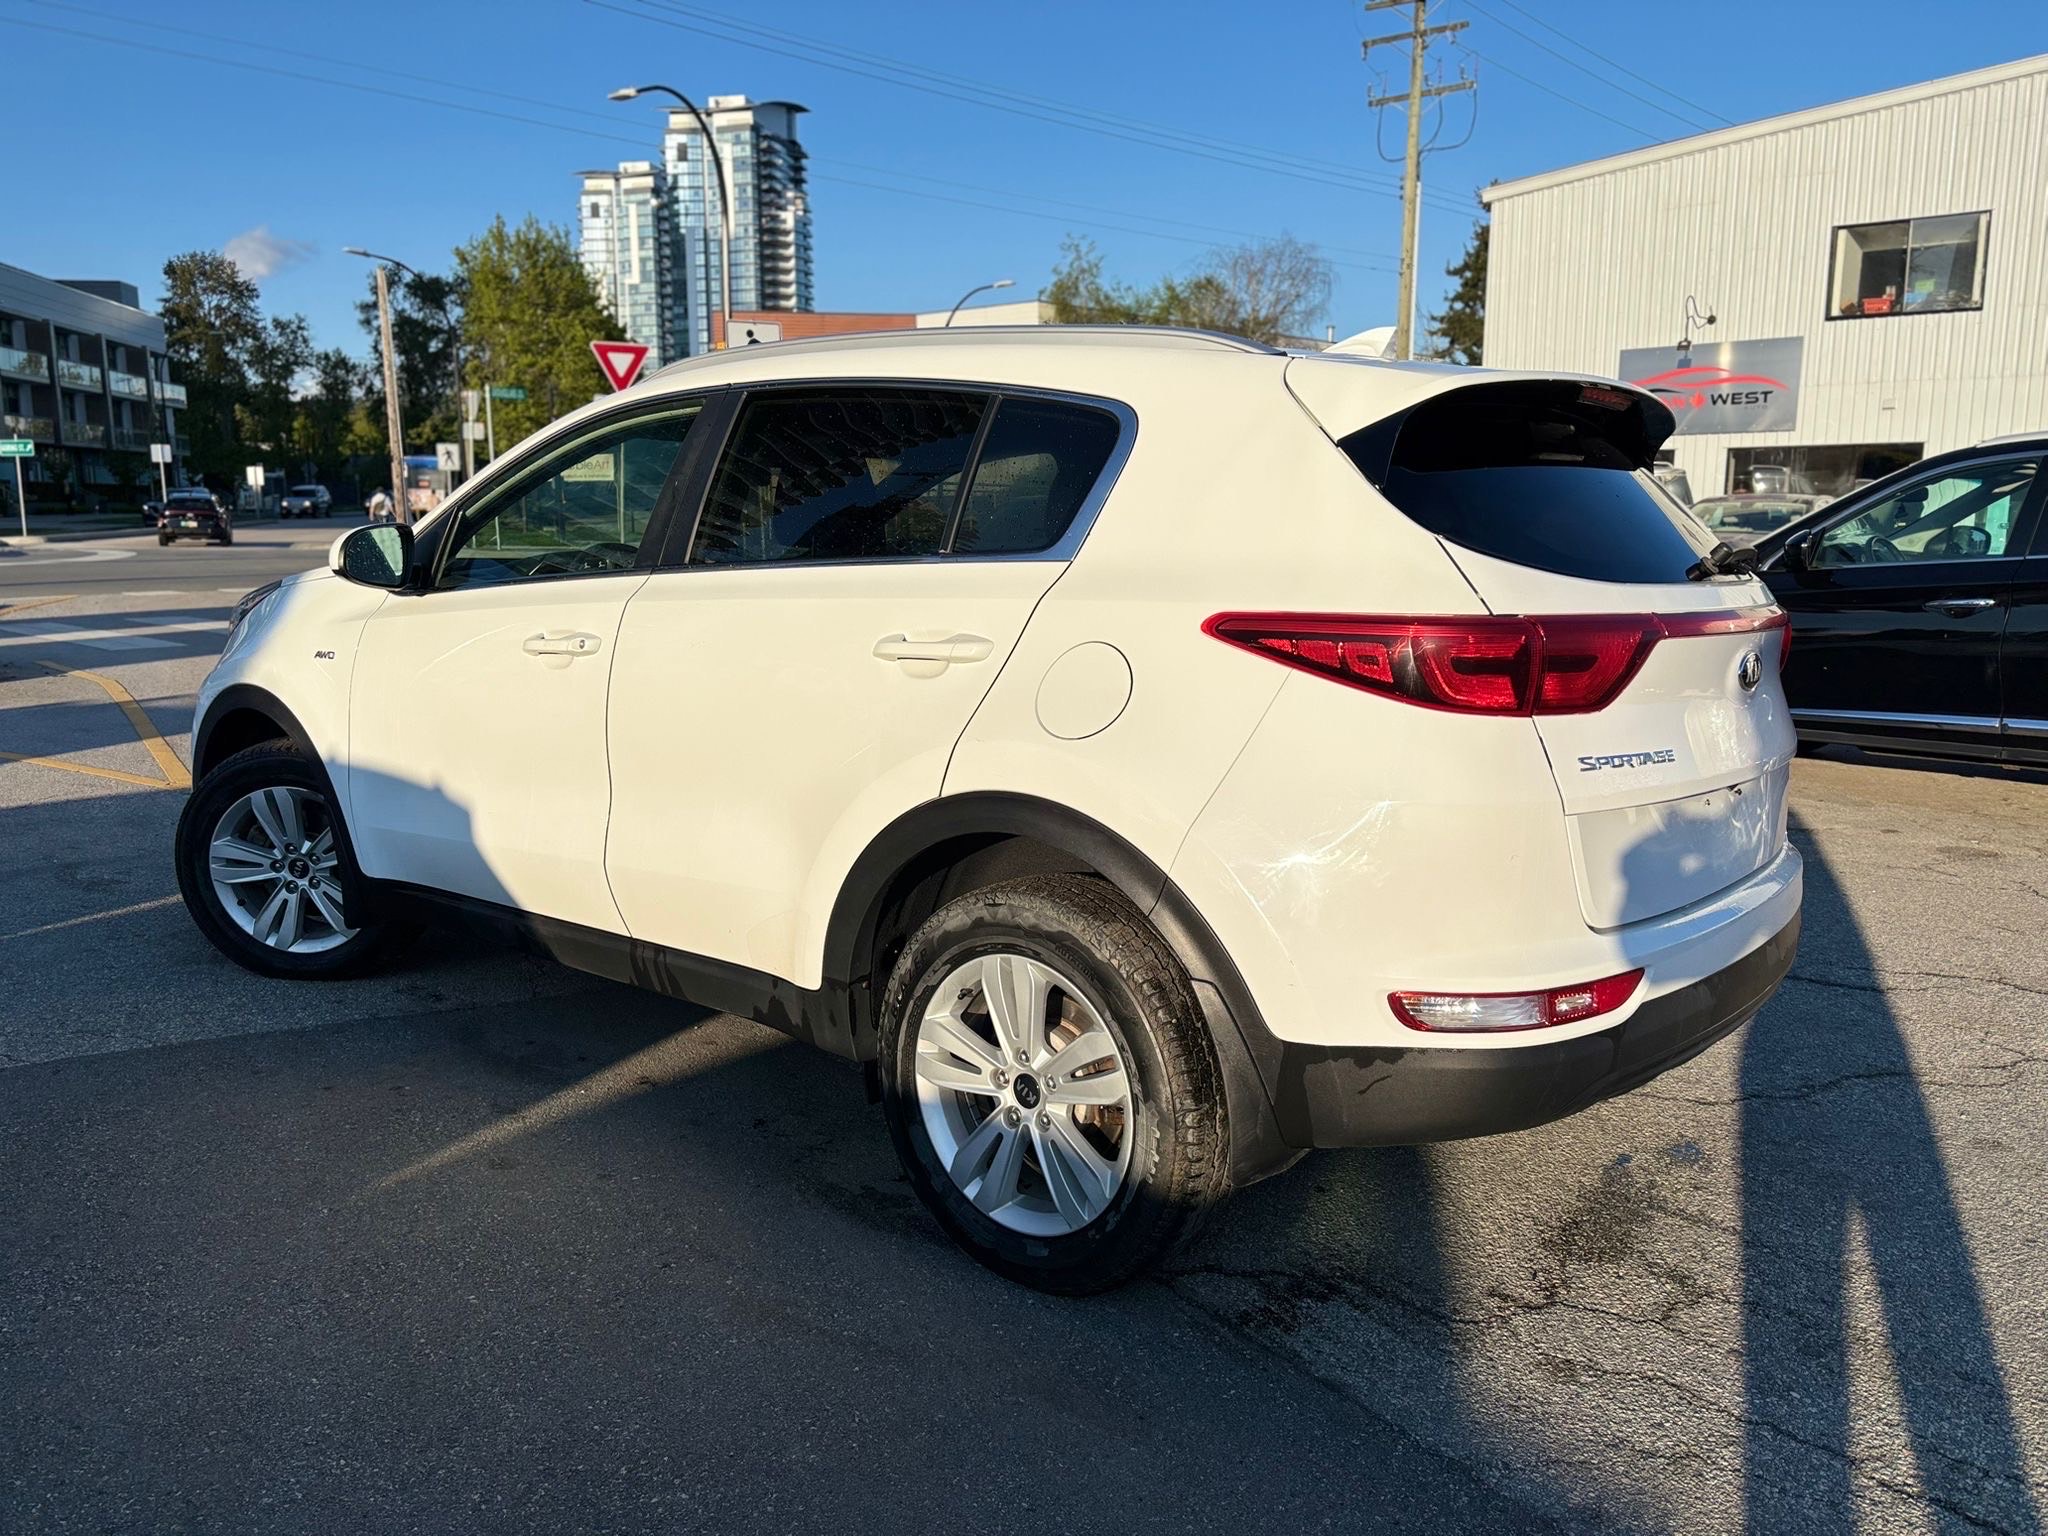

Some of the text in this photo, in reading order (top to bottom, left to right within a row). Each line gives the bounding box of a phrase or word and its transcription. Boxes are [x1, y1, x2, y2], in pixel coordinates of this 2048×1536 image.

[1710, 390, 1774, 406] WEST
[314, 650, 335, 660] AWD
[1578, 749, 1676, 772] SPORTAGE
[1016, 1078, 1037, 1104] KIA
